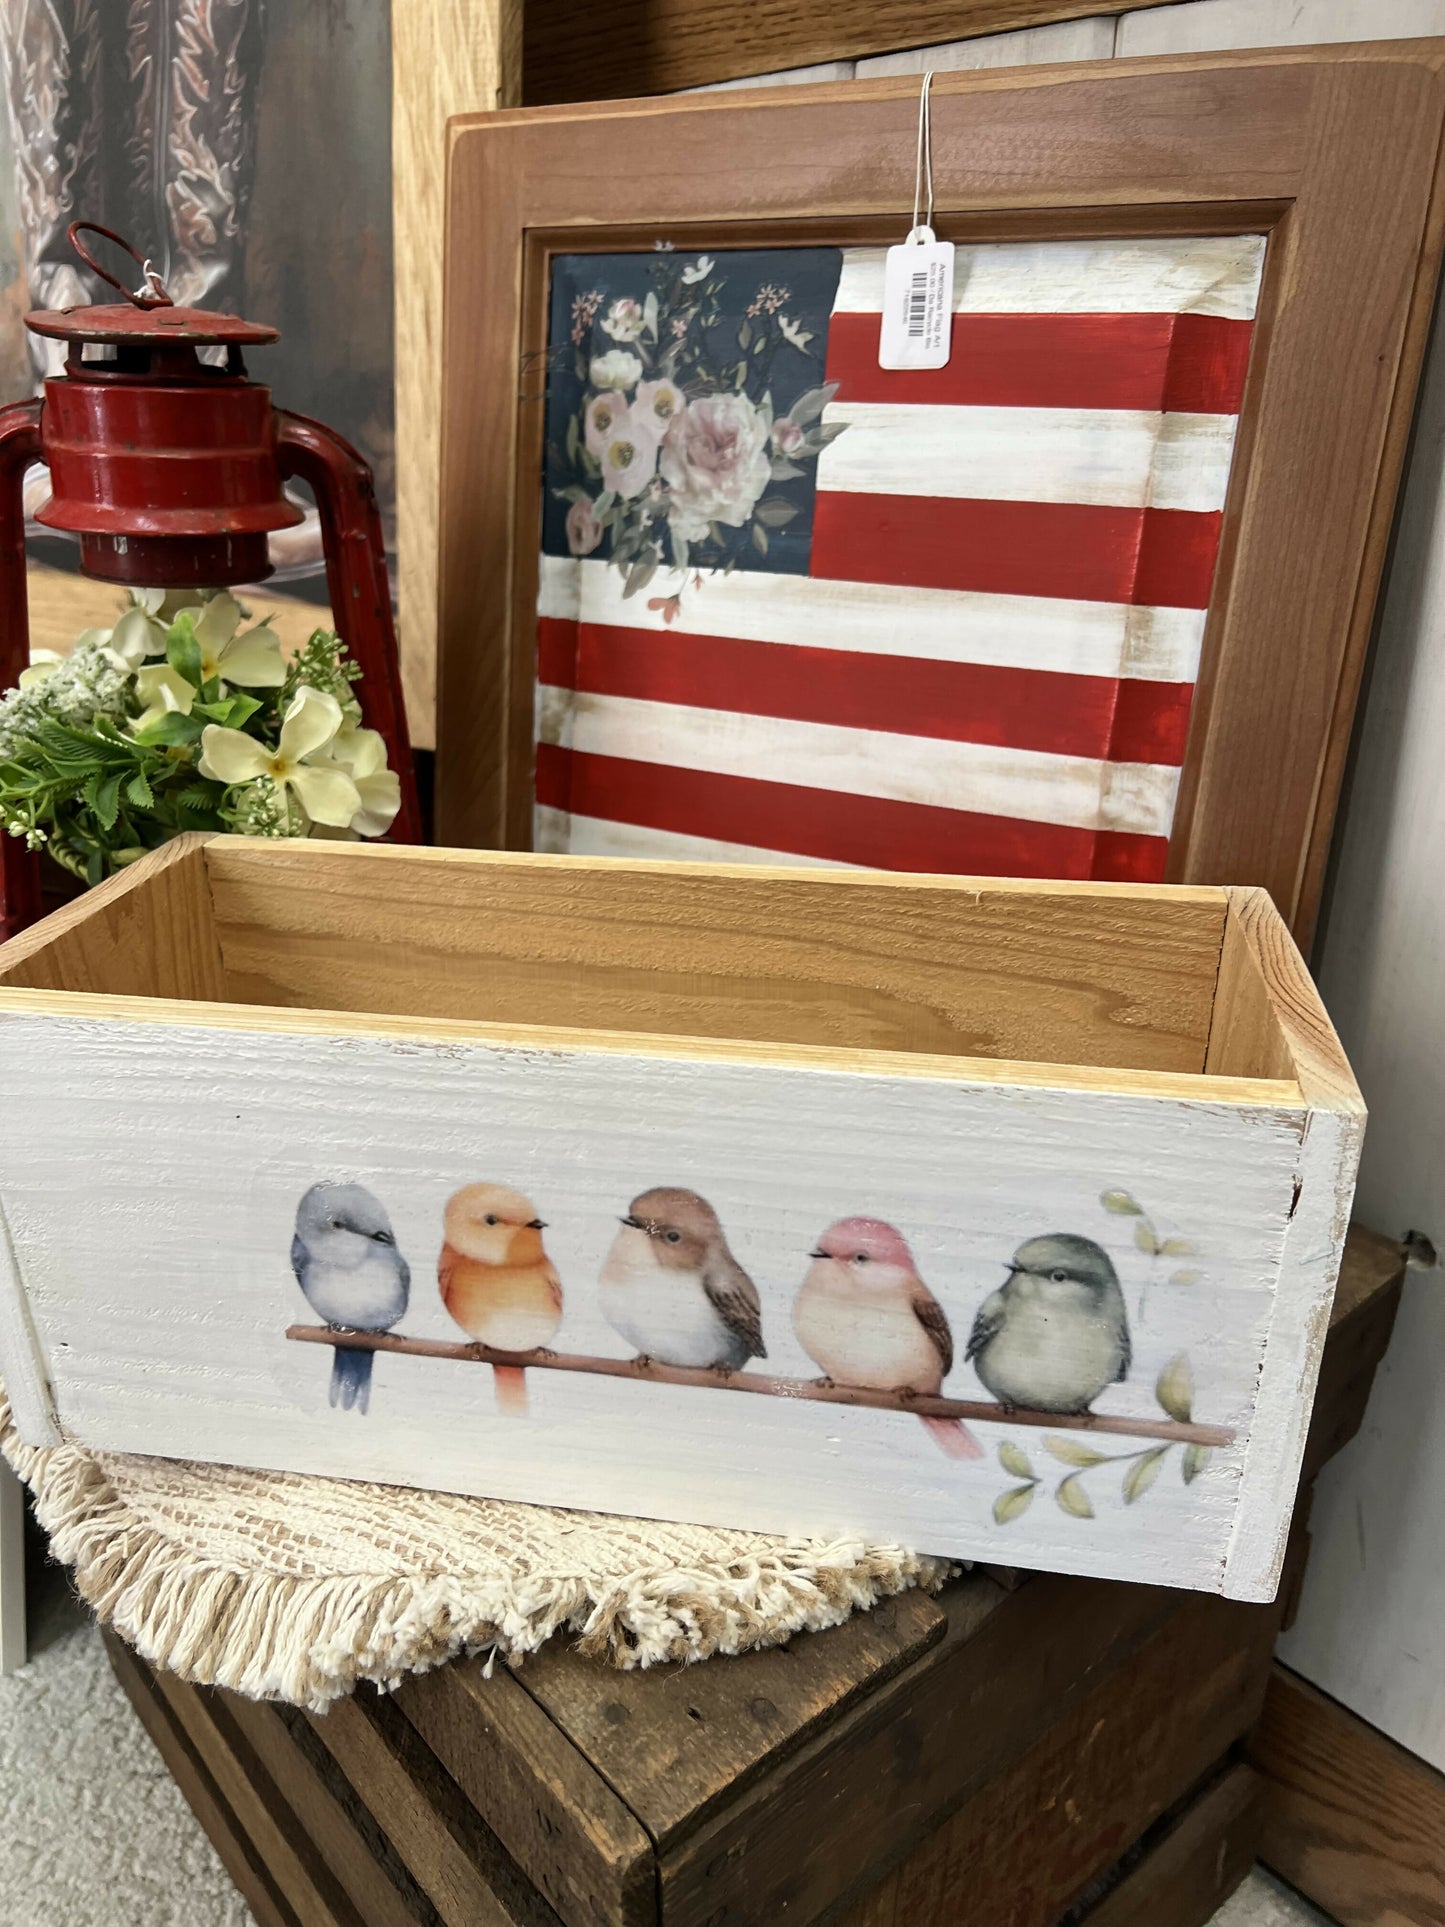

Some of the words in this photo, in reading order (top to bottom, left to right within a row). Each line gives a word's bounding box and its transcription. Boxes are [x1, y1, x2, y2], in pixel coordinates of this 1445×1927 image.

[929, 262, 937, 288] $2500
[937, 263, 946, 311] Americana
[934, 312, 944, 333] Flag
[933, 335, 941, 348] Art
